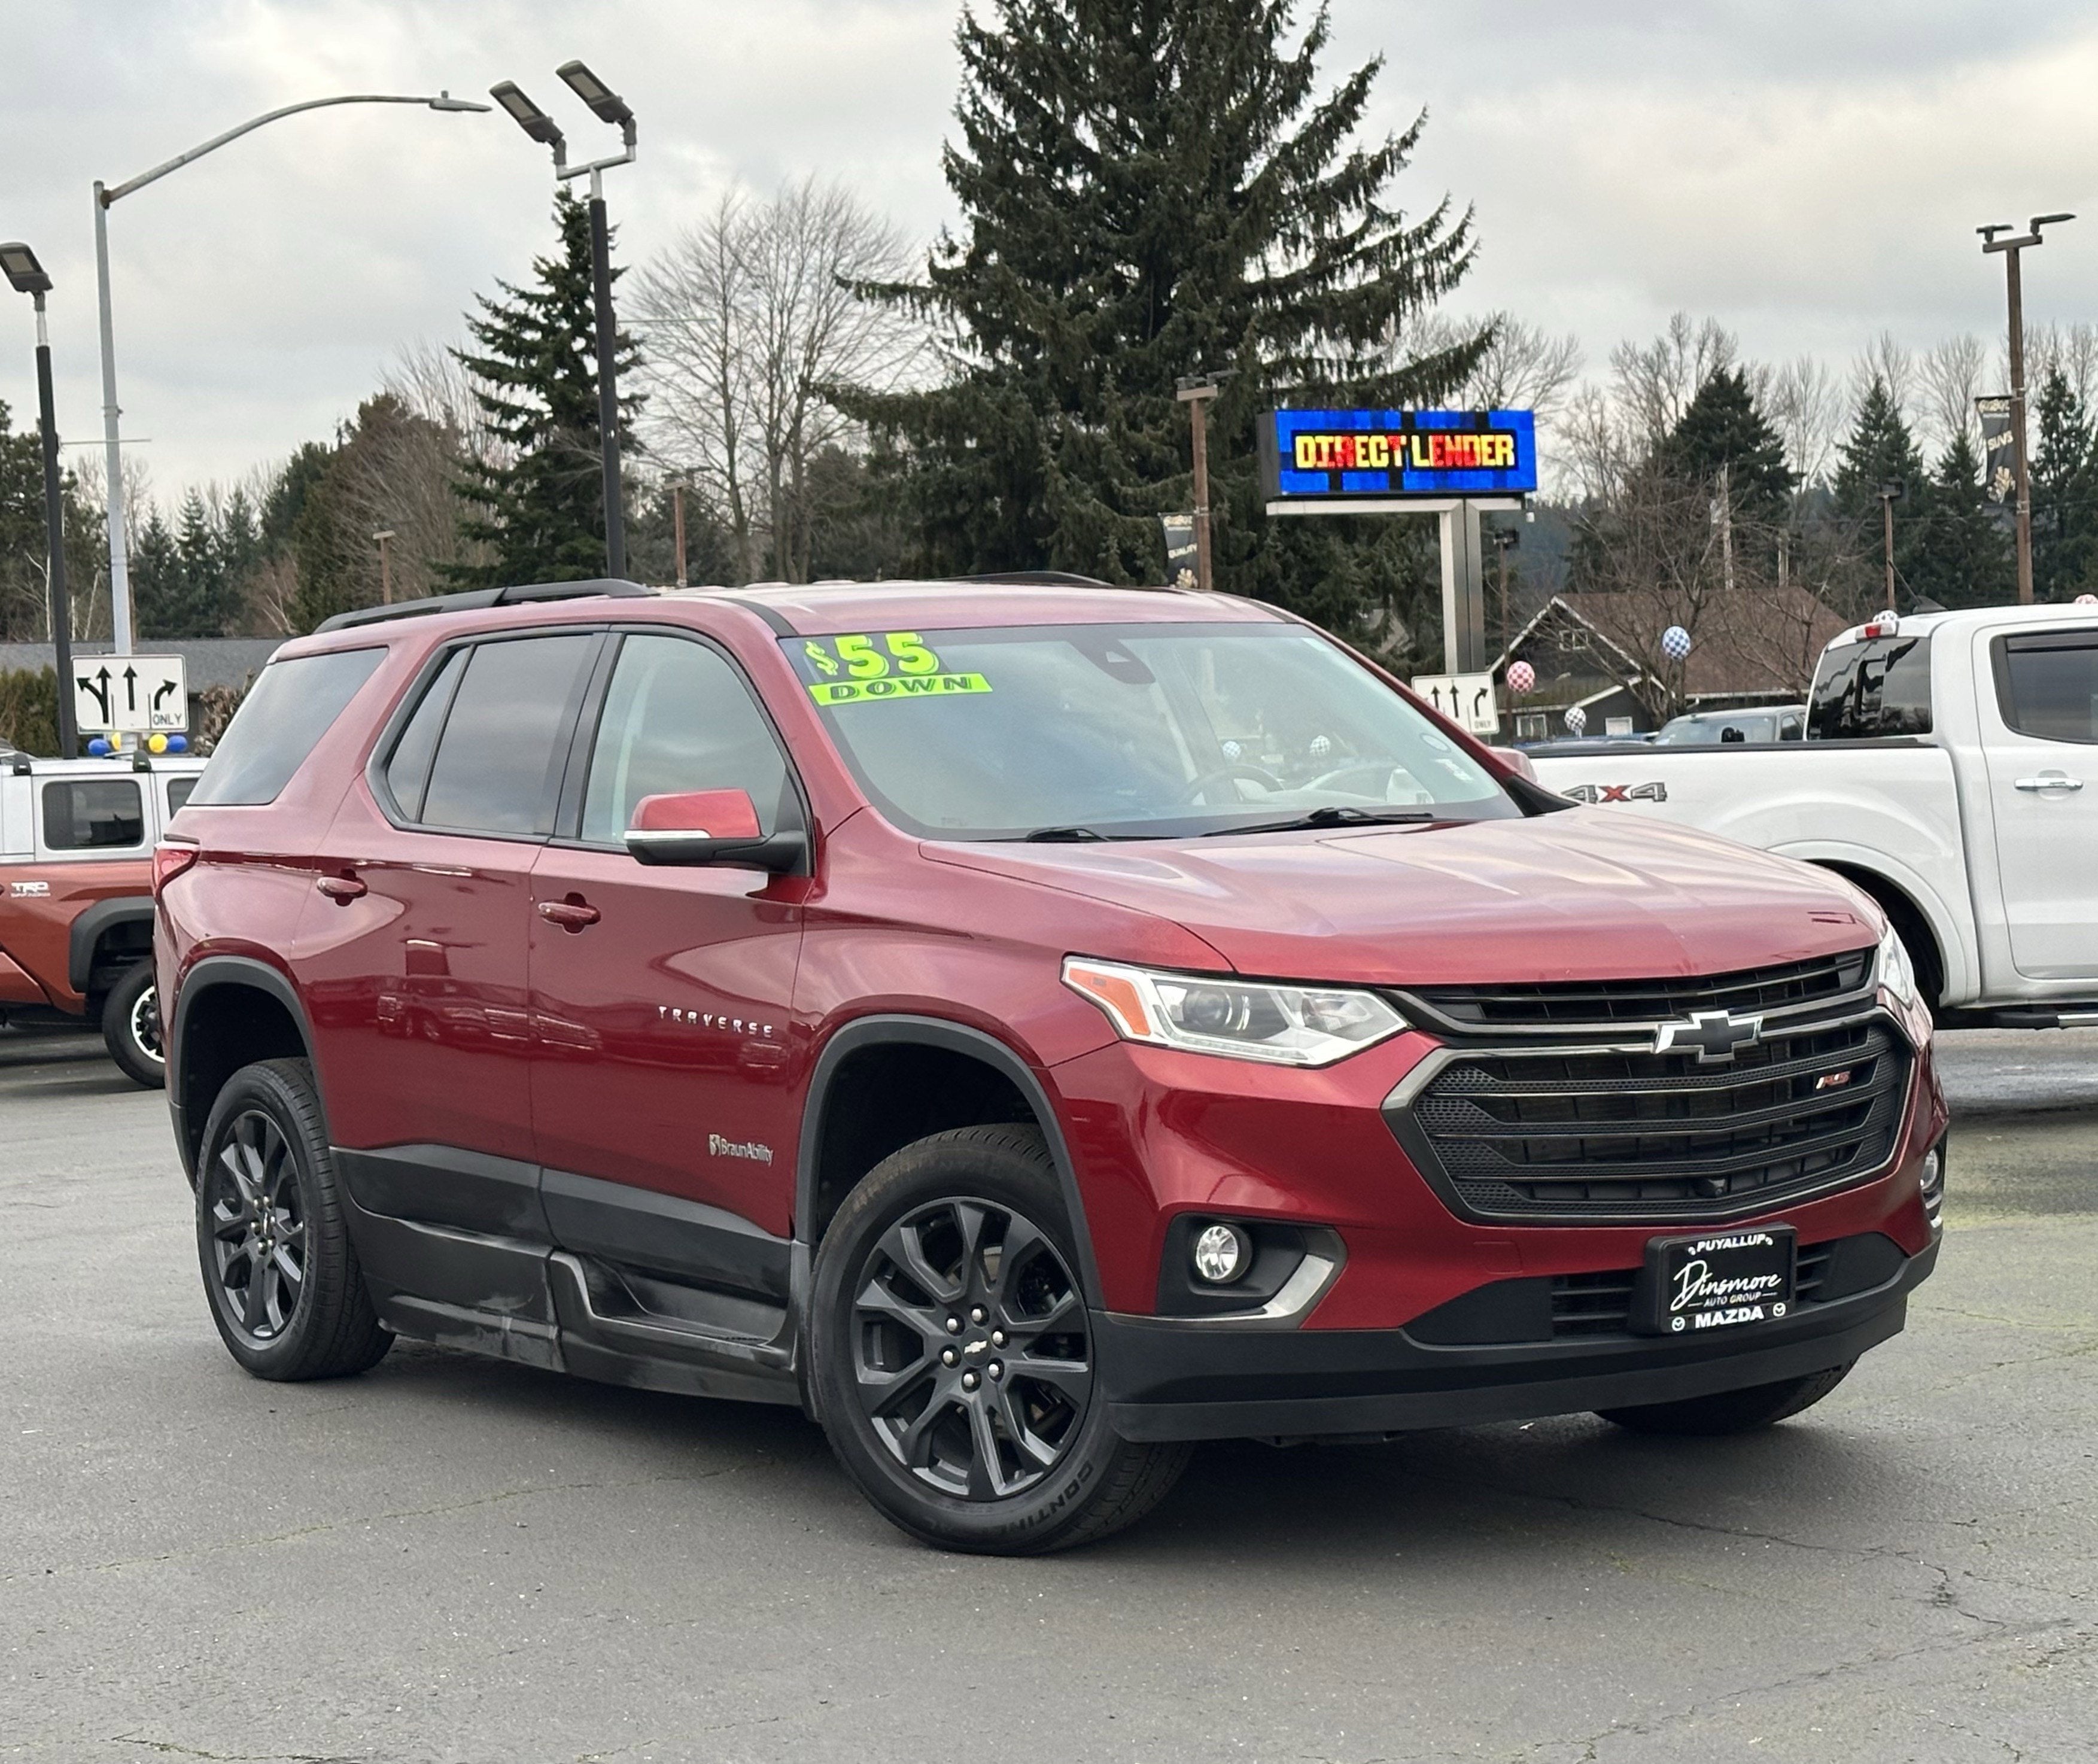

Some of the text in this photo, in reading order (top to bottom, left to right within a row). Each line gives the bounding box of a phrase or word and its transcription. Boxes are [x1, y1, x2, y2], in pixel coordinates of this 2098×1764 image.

[1295, 435, 1515, 468] DIRECT LENDER
[805, 632, 939, 679] $55
[831, 676, 972, 700] DOWN
[153, 713, 182, 725] ONLY
[1474, 720, 1491, 729] ONLY
[659, 1006, 774, 1038] TRAVERSE
[720, 1138, 774, 1166] BraunAbility
[1697, 1233, 1766, 1252] PUYALLUP
[1670, 1260, 1782, 1311] Dinsmore
[1704, 1291, 1761, 1307] AUTO GROUP
[1695, 1306, 1765, 1329] MAZDA
